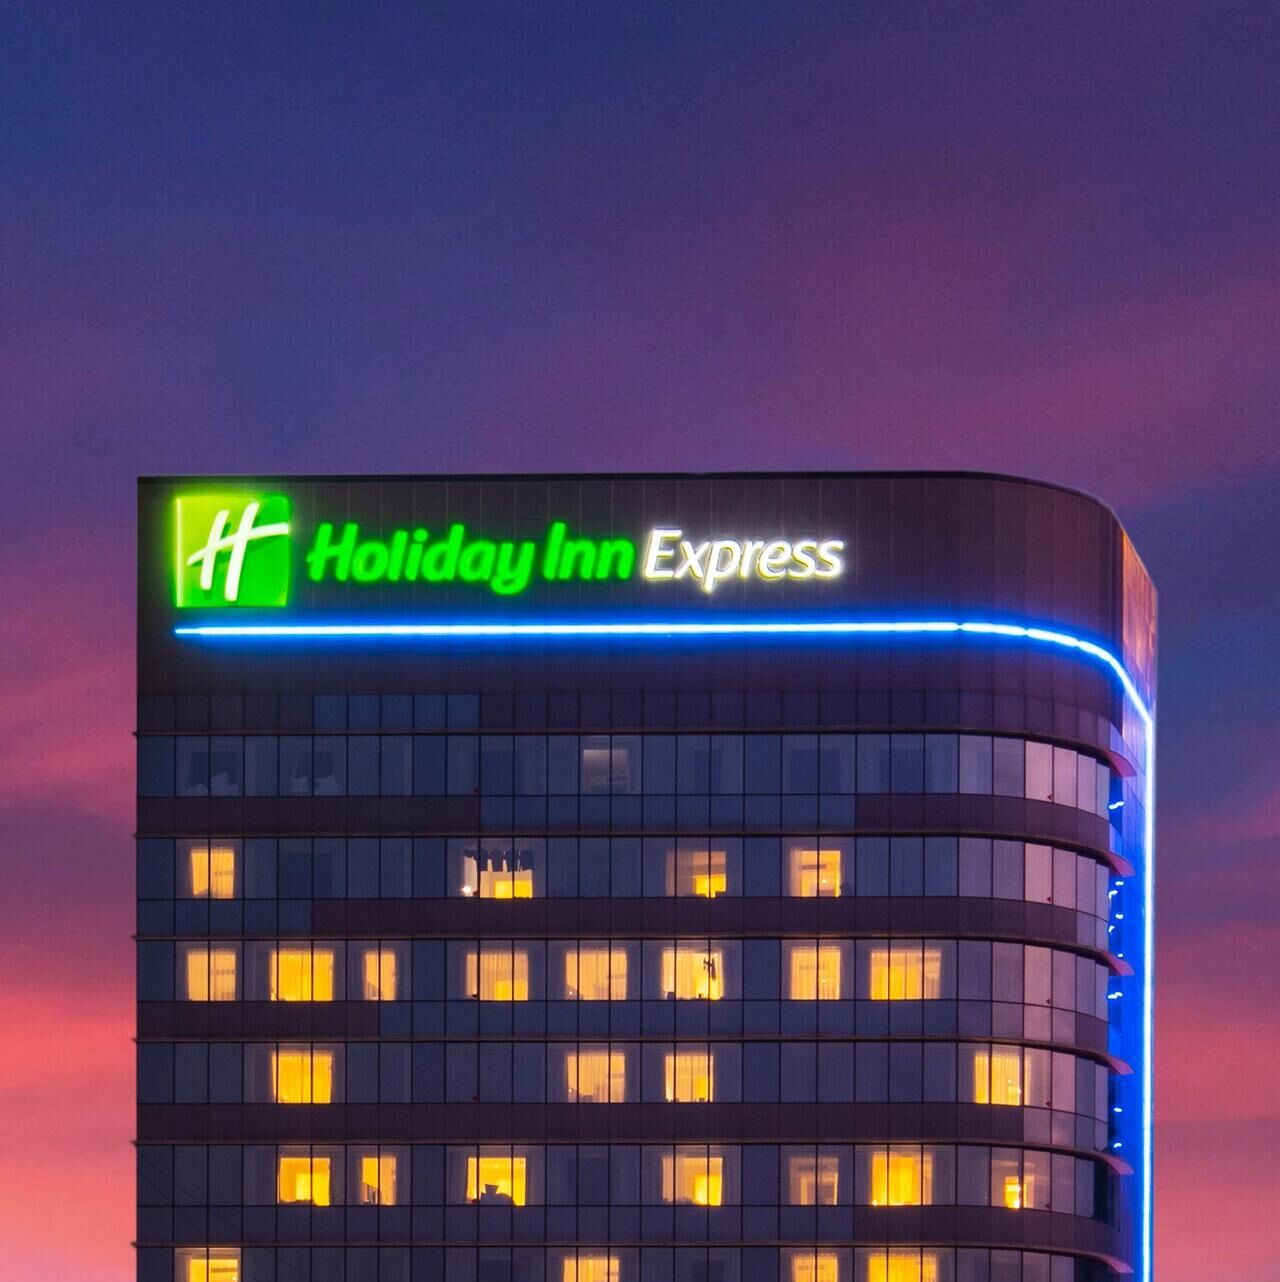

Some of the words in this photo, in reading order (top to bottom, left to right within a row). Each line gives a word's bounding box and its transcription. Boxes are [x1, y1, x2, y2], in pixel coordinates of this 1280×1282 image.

[187, 501, 289, 602] H
[306, 522, 536, 595] Holiday
[543, 521, 635, 580] Inn
[643, 528, 845, 593] Express
